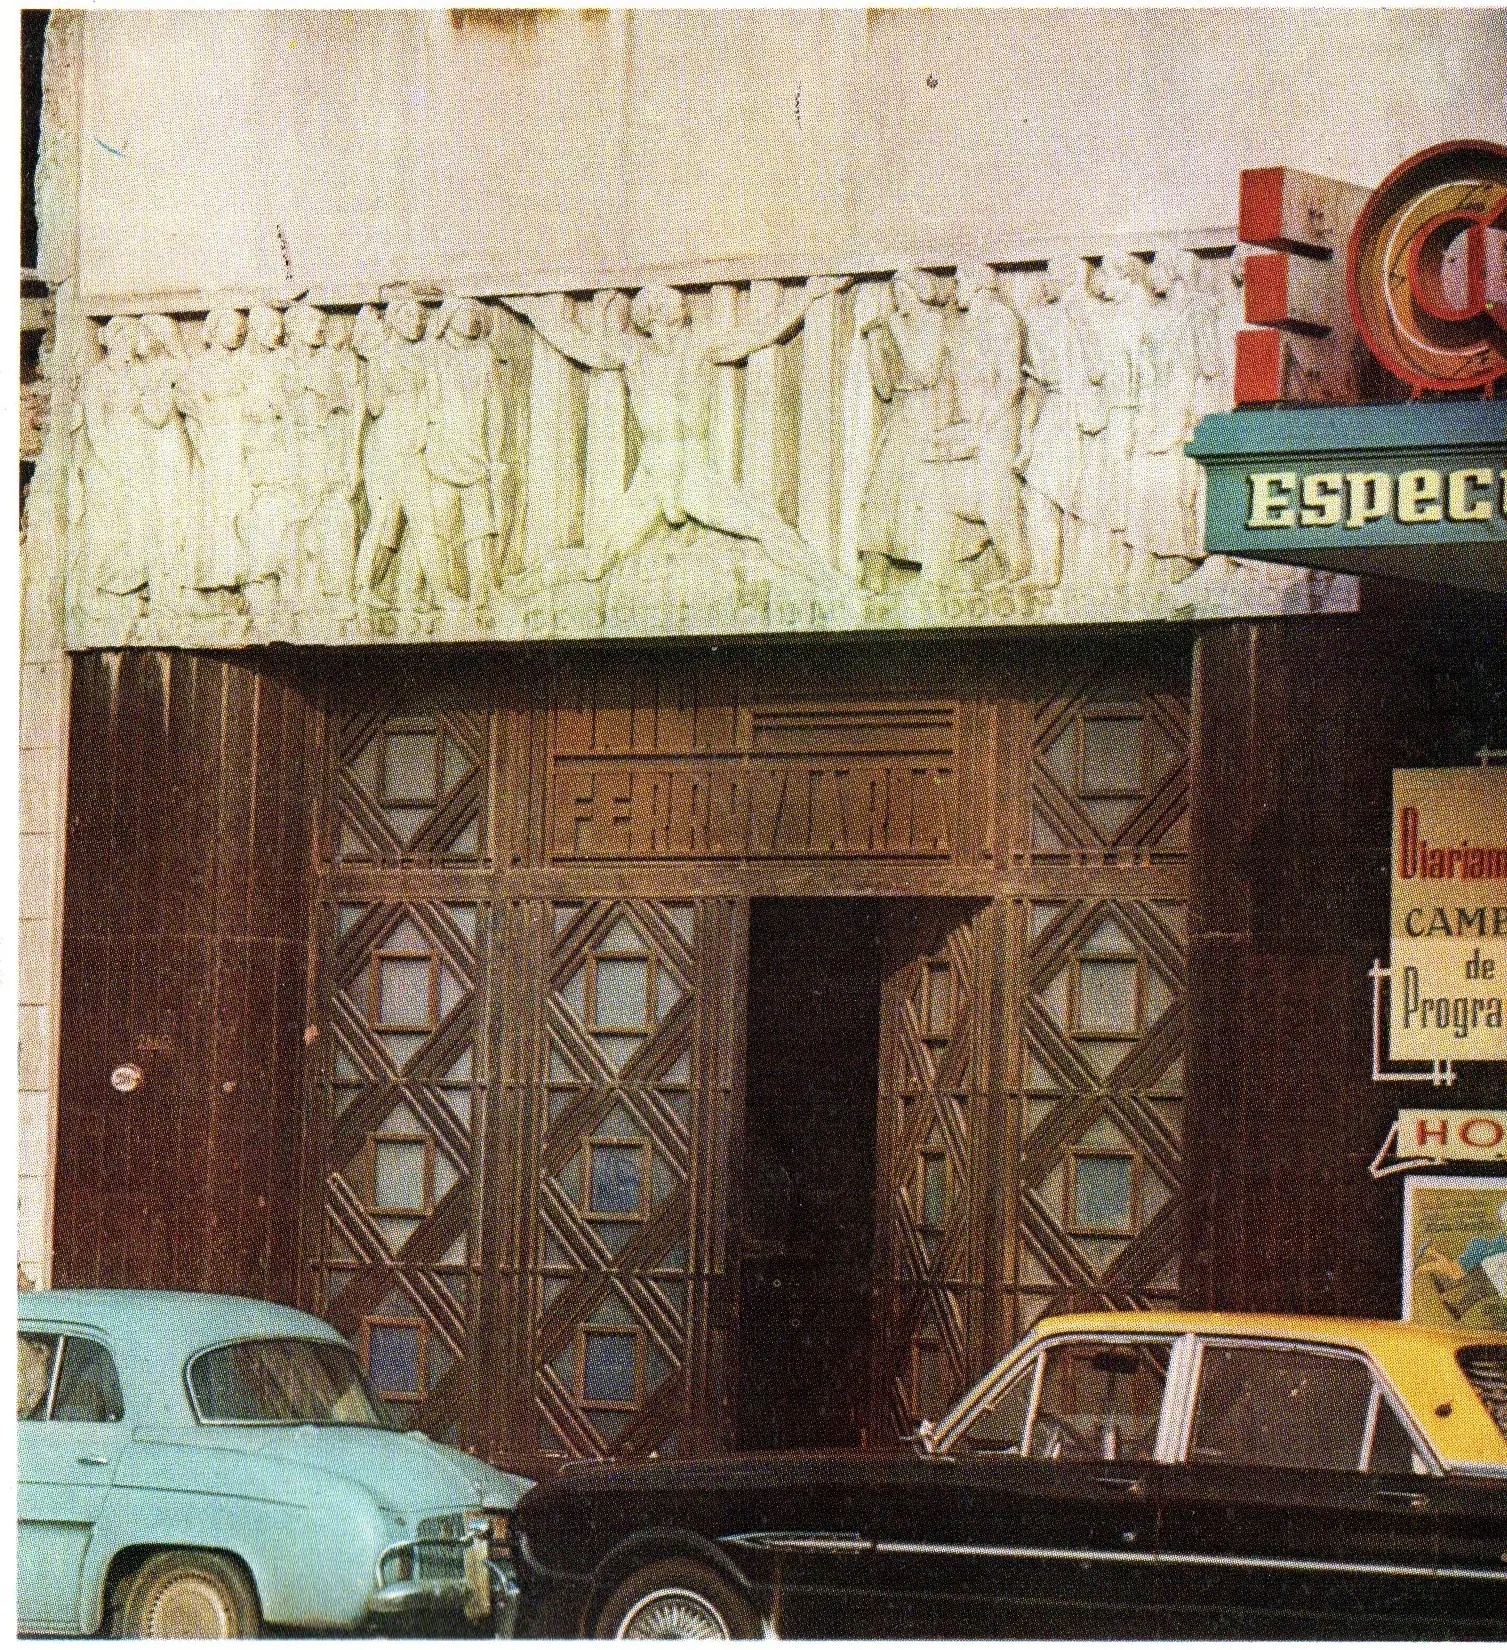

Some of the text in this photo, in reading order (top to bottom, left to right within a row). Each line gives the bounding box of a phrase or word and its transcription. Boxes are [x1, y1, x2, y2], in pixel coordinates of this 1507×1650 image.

[1246, 468, 1507, 529] Espec
[1466, 948, 1496, 979] de
[1416, 1117, 1503, 1147] HO
